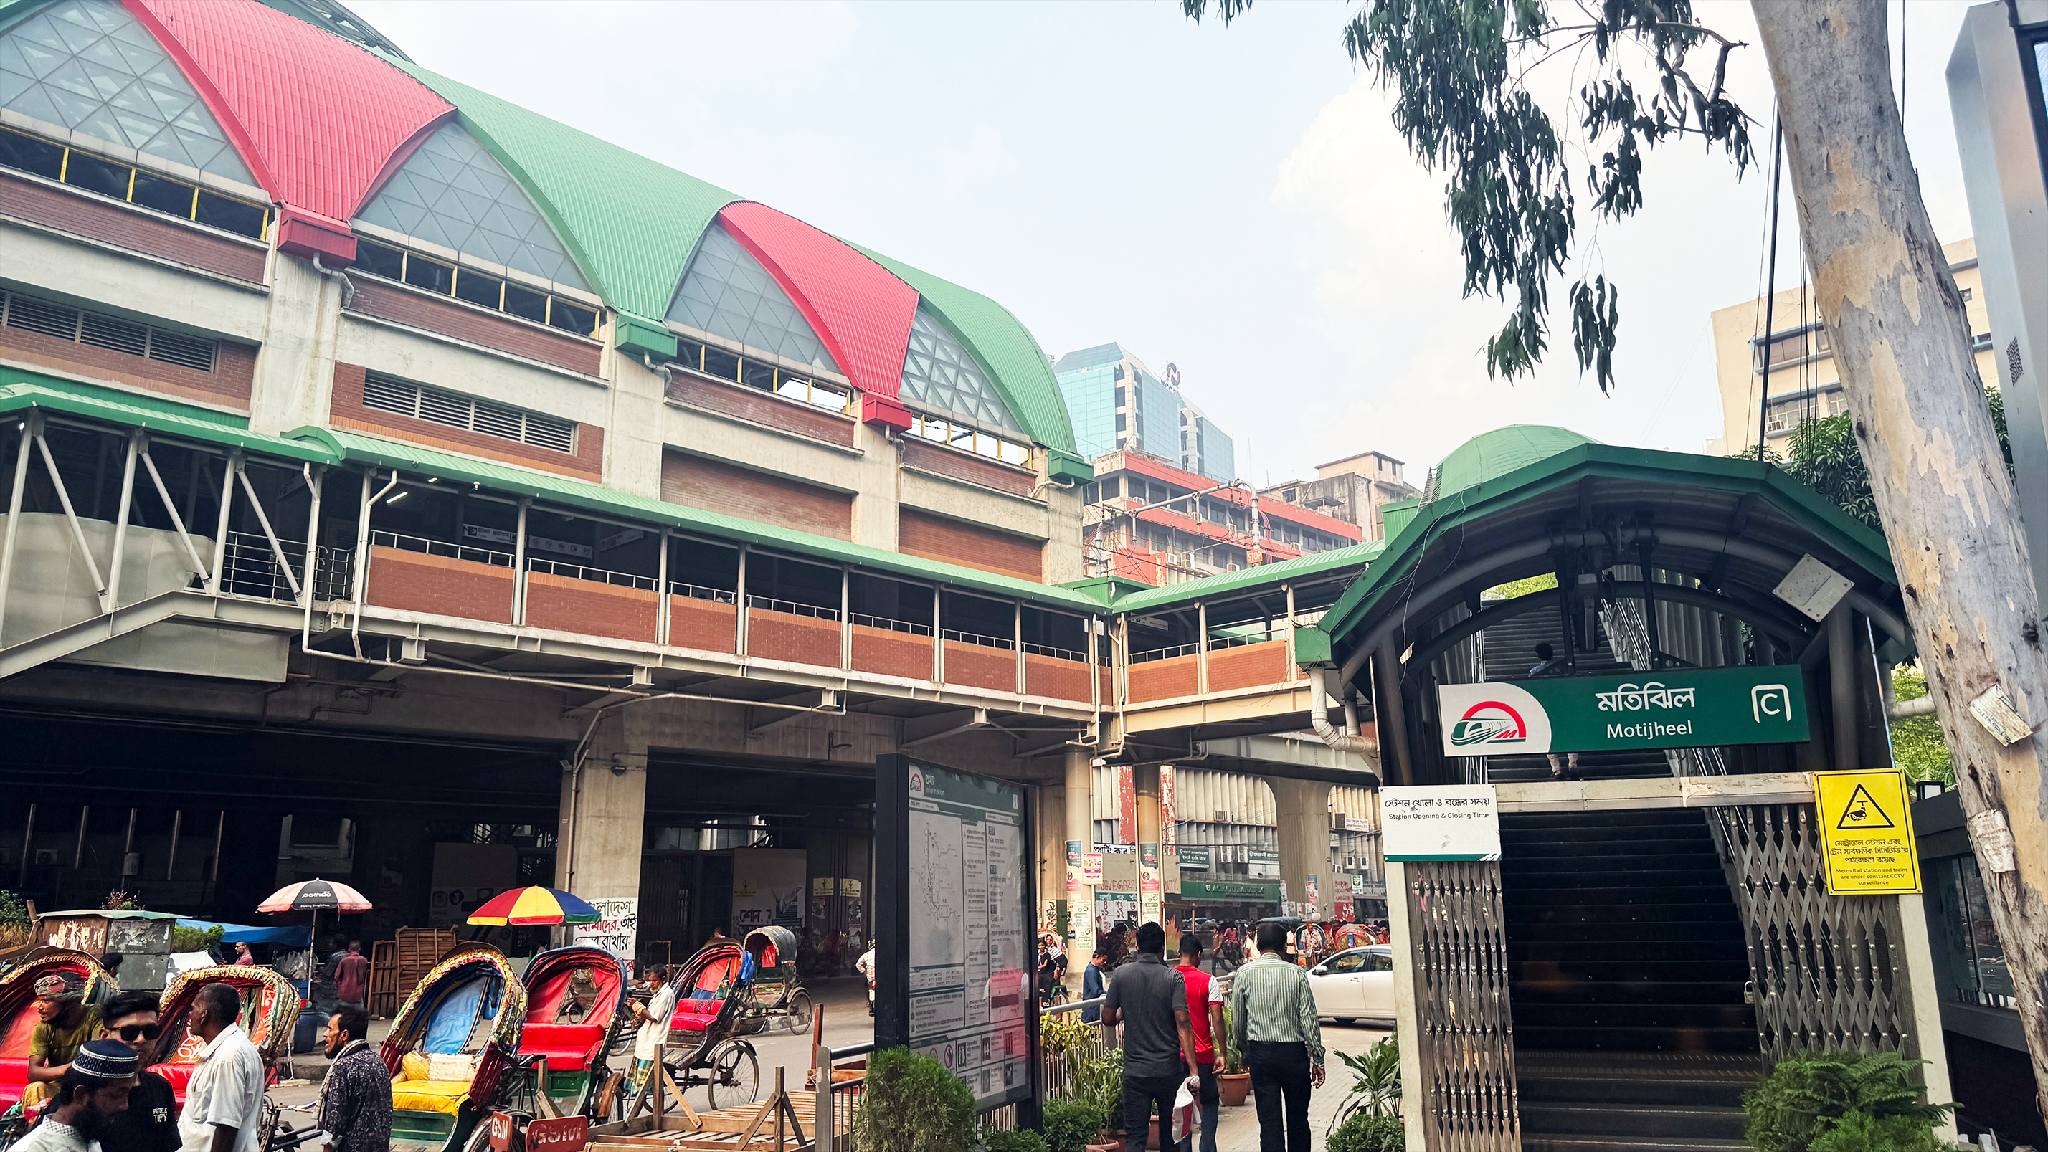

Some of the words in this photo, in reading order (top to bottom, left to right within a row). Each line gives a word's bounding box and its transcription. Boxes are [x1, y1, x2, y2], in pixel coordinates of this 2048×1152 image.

[1247, 551, 1262, 561] STOP
[1595, 682, 1696, 712] মতিঝিল
[1760, 693, 1781, 714] C
[1607, 720, 1693, 740] Motijheel
[1384, 798, 1411, 807] স্টেশন
[1436, 798, 1443, 807] ও
[1412, 813, 1440, 821] Opening
[1447, 812, 1472, 820] Closing
